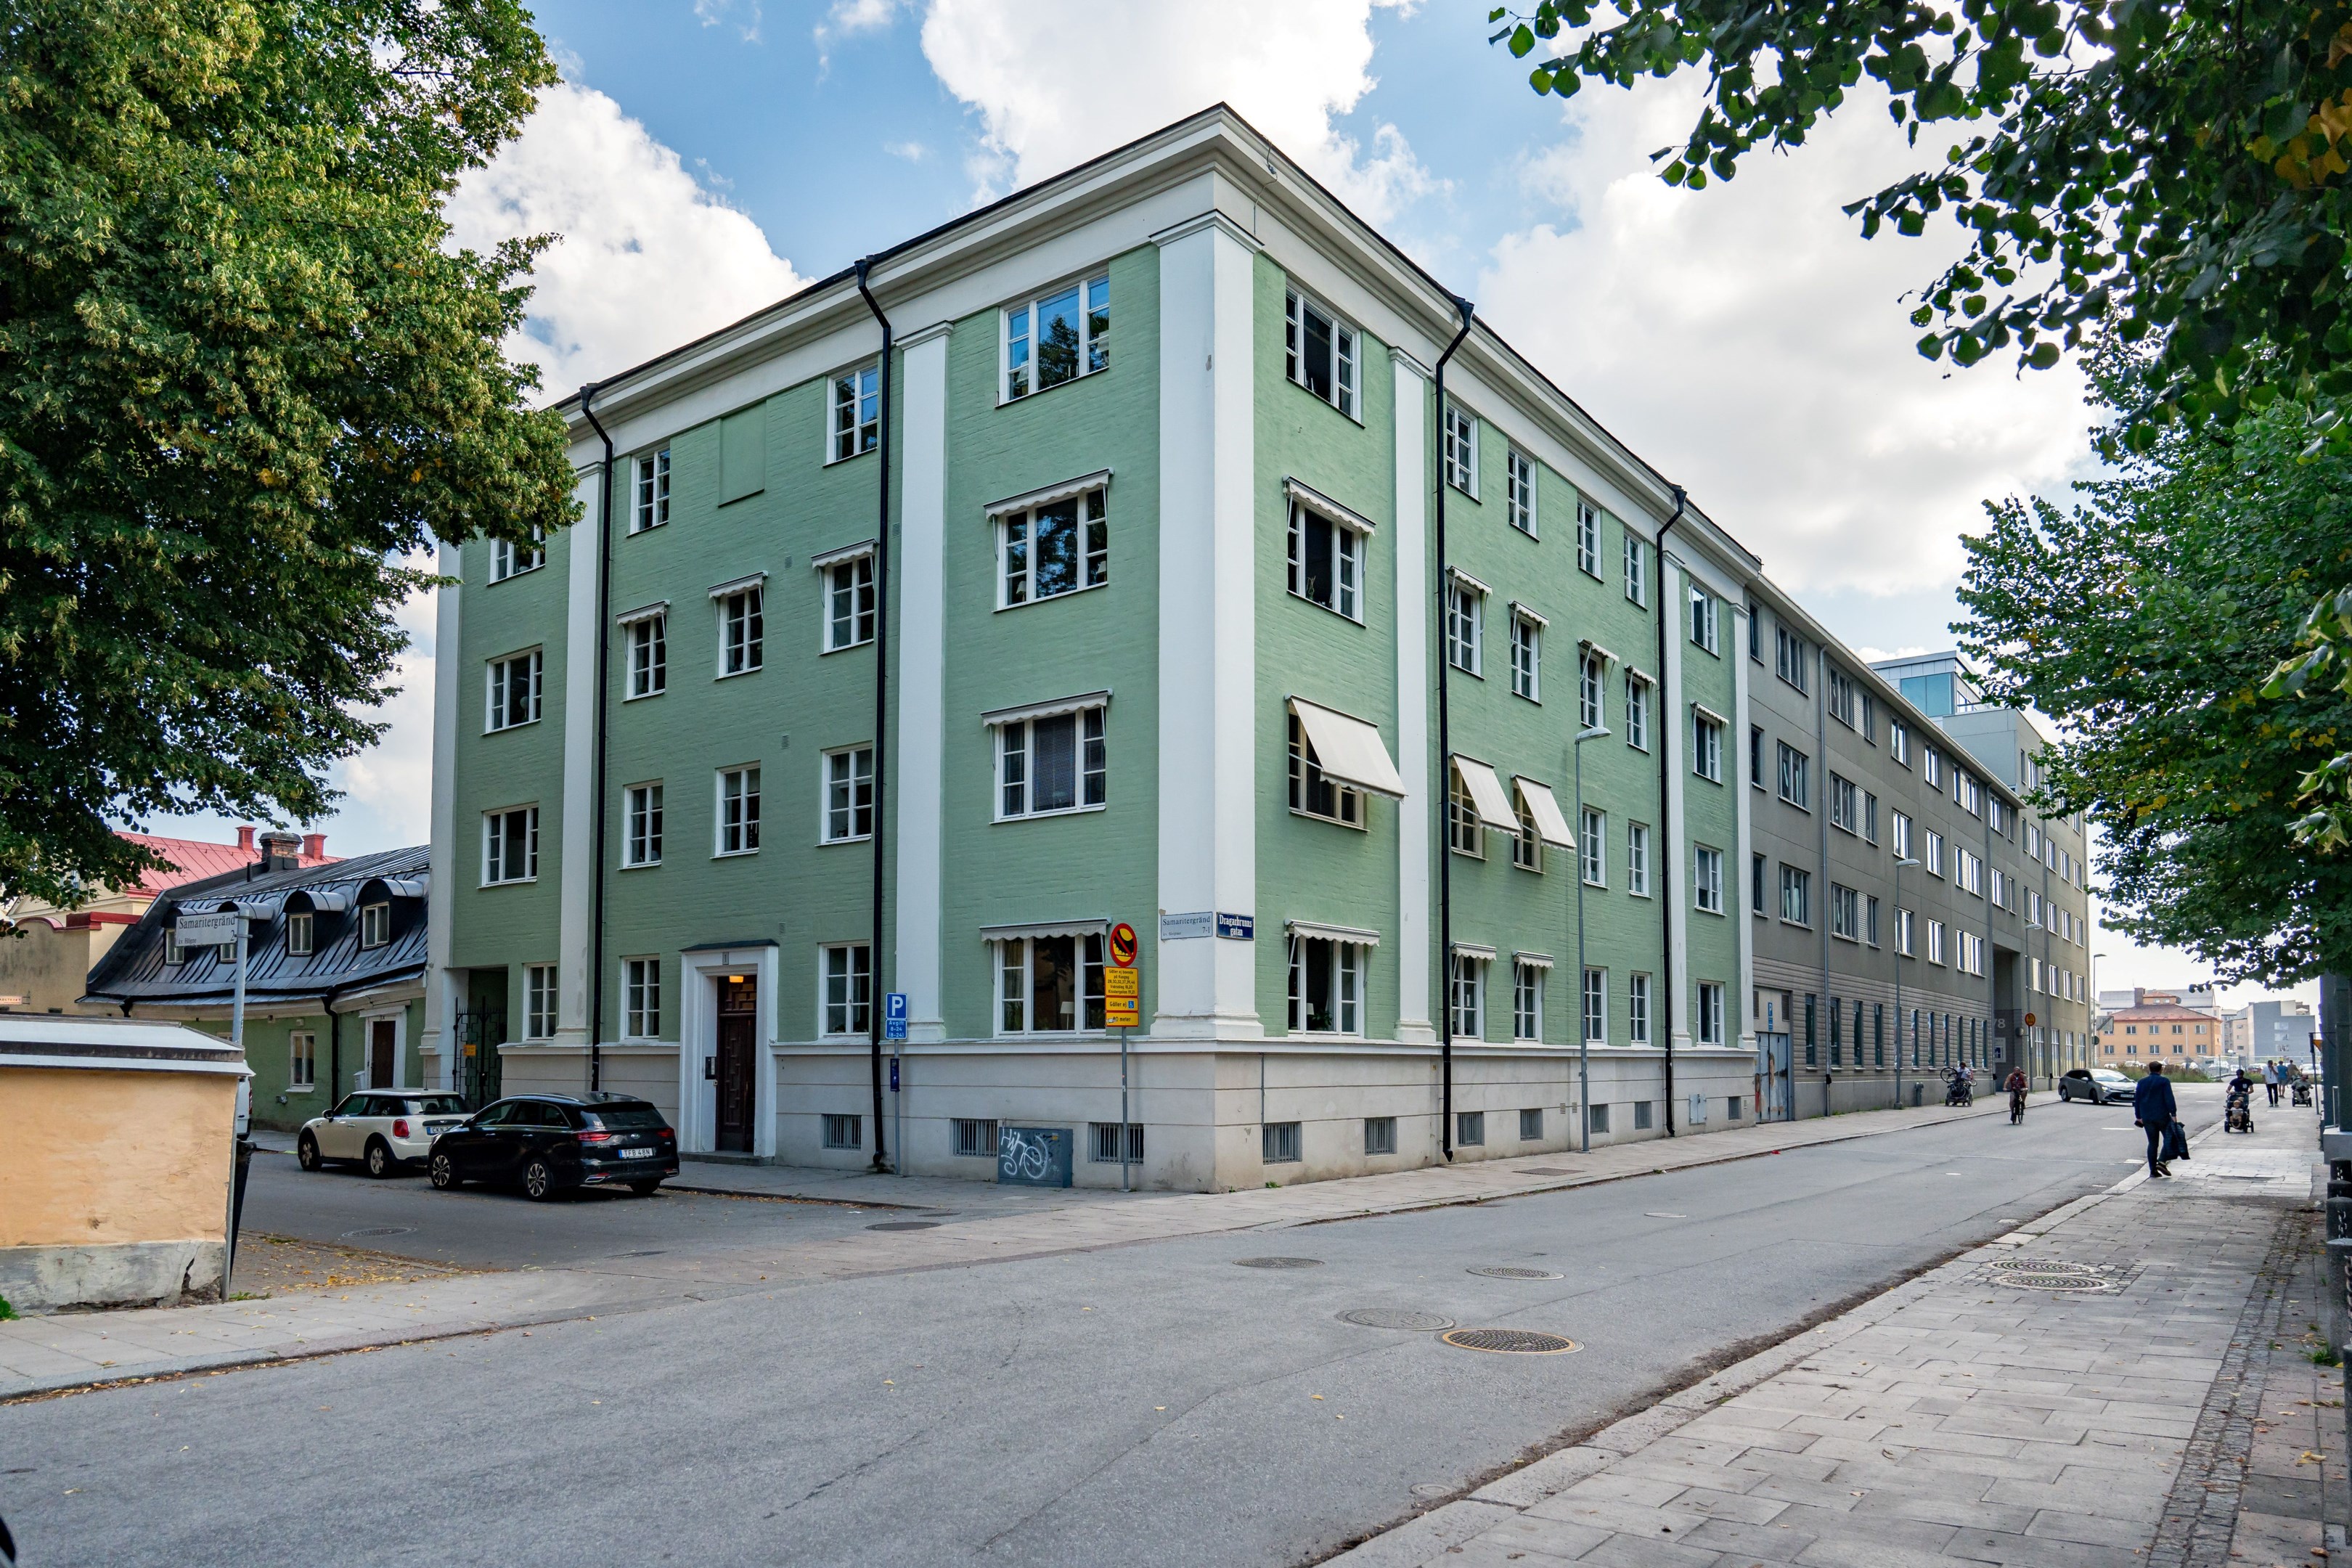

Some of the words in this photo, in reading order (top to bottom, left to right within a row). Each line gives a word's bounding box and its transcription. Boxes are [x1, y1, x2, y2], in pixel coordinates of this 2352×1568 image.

[179, 914, 235, 928] Samaritergränd
[1162, 915, 1210, 926] Samaritergränd
[1219, 914, 1252, 928] Dragarbrunns
[230, 930, 234, 941] 2
[1230, 927, 1243, 936] gatan
[891, 996, 903, 1016] P
